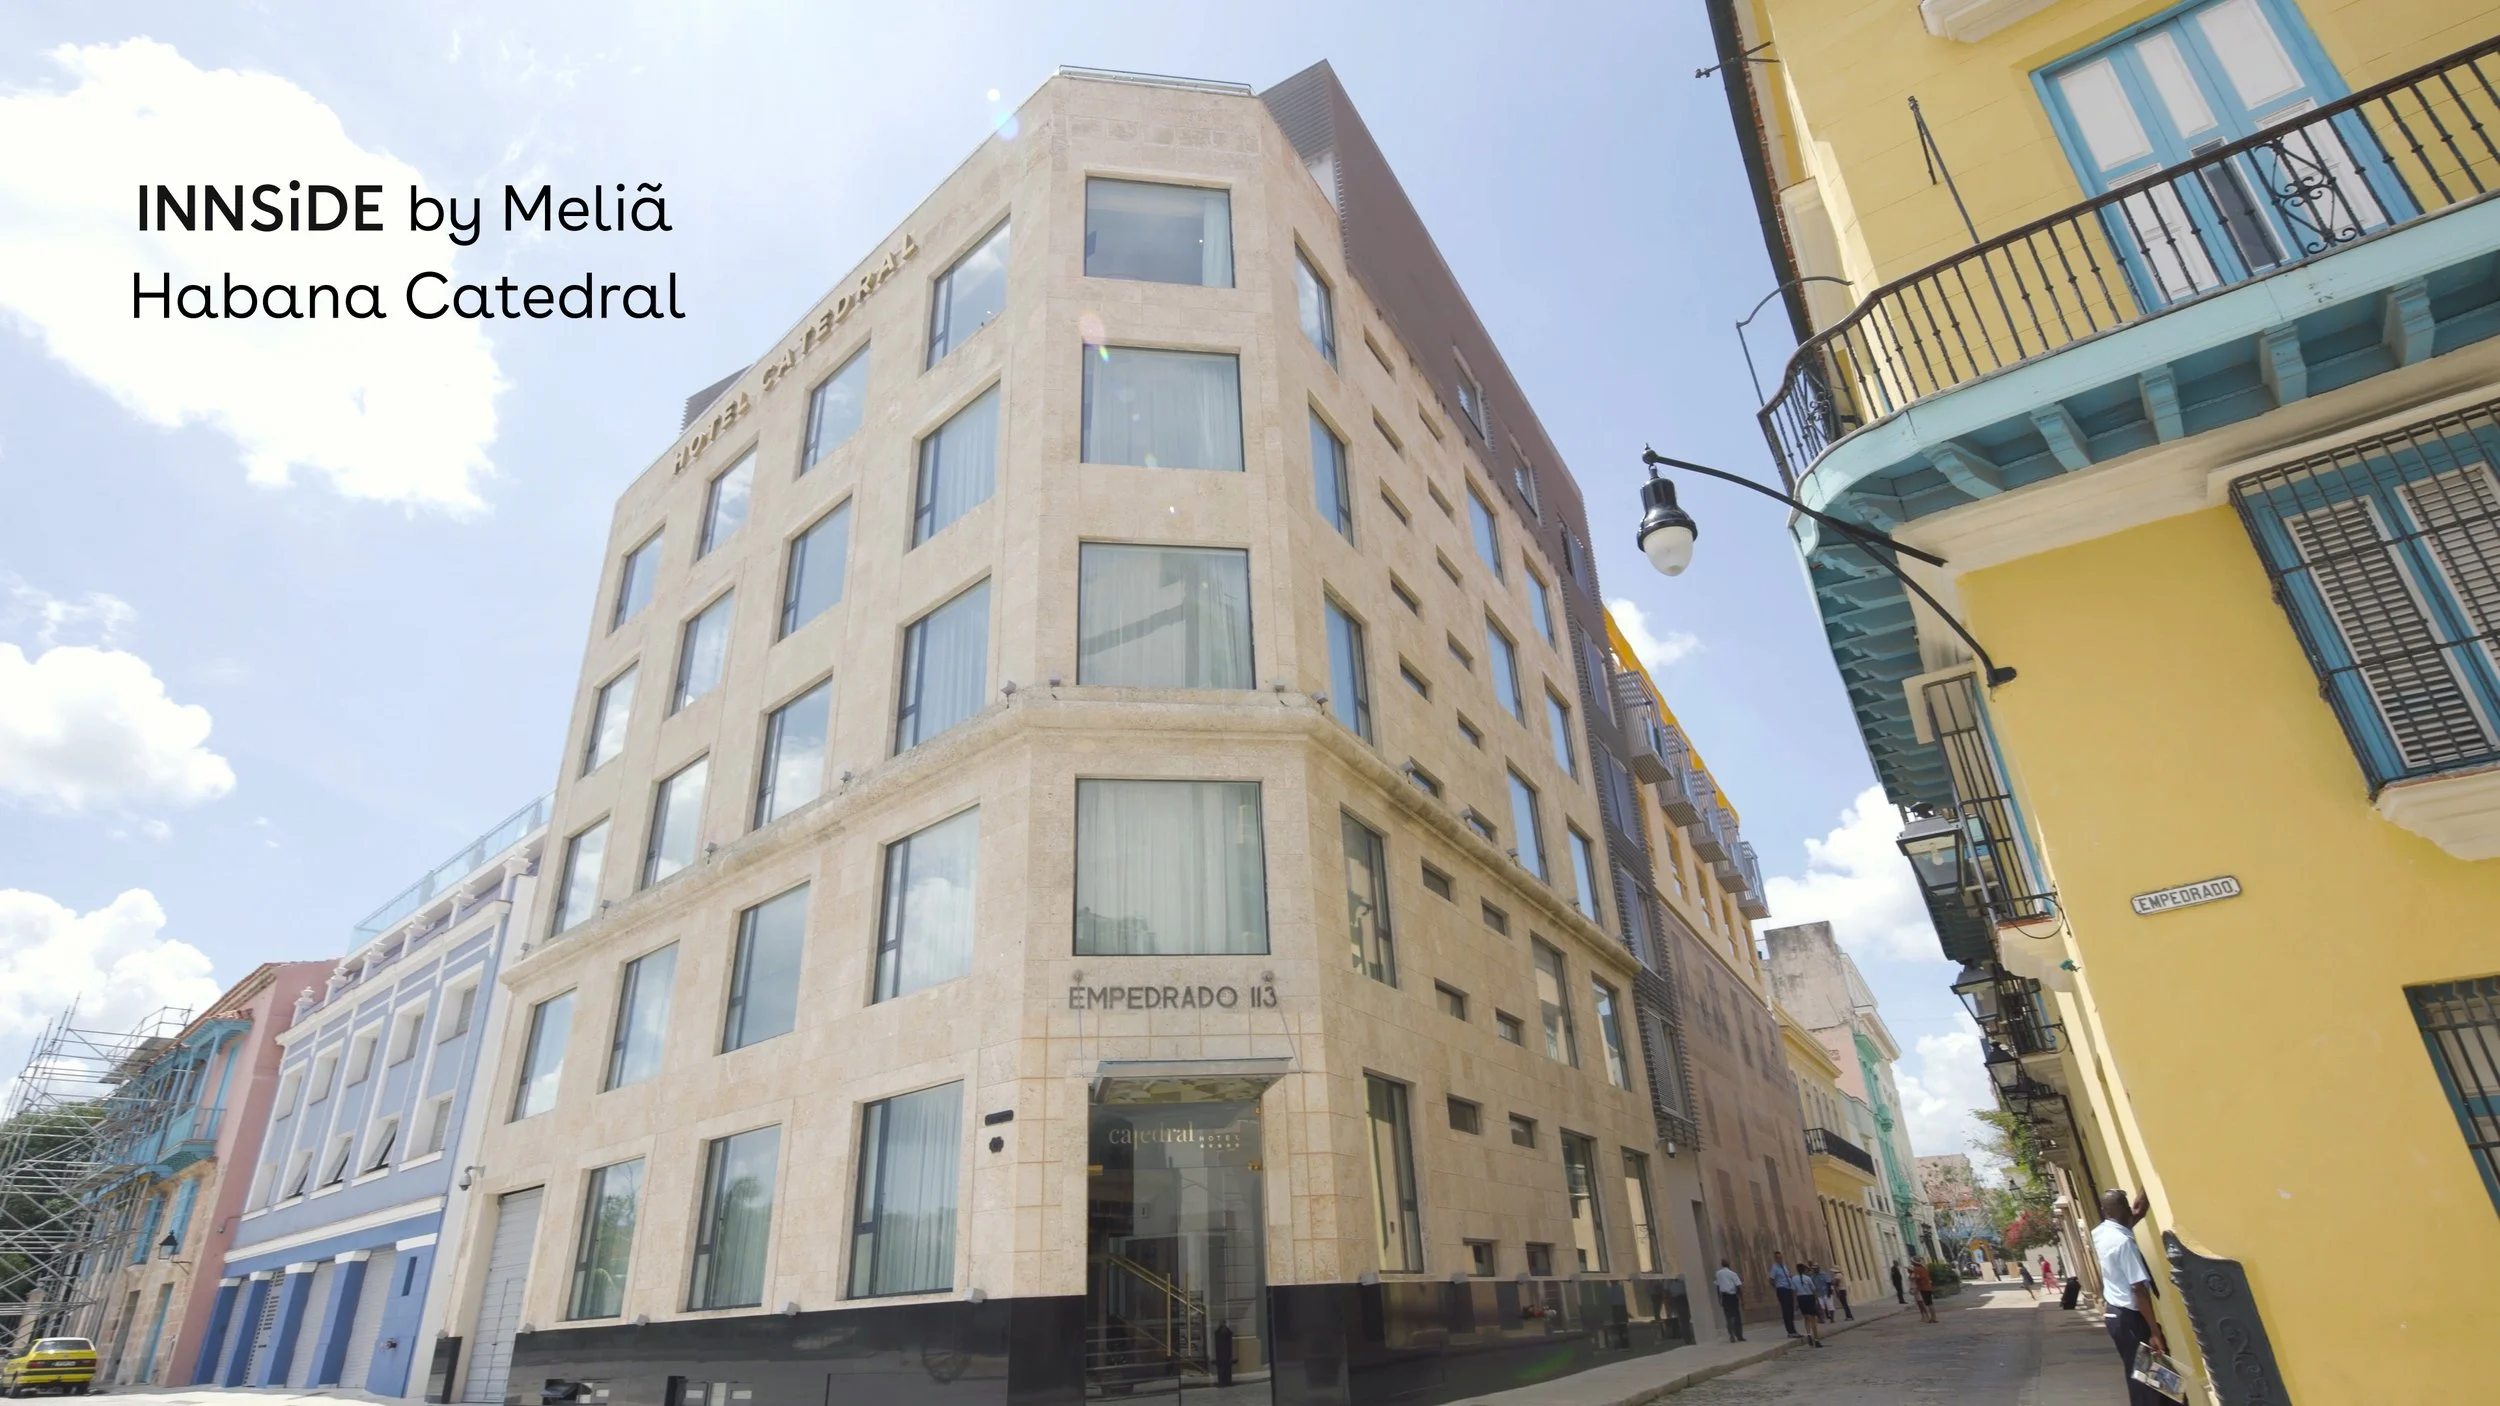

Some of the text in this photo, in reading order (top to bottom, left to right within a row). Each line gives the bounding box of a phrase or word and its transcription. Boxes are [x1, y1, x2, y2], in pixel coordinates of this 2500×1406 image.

[673, 232, 919, 475] HOTEL CATEDRAL
[2138, 879, 2234, 912] EMPEDRADO
[1068, 986, 1279, 1011] EMPEDRADO 113
